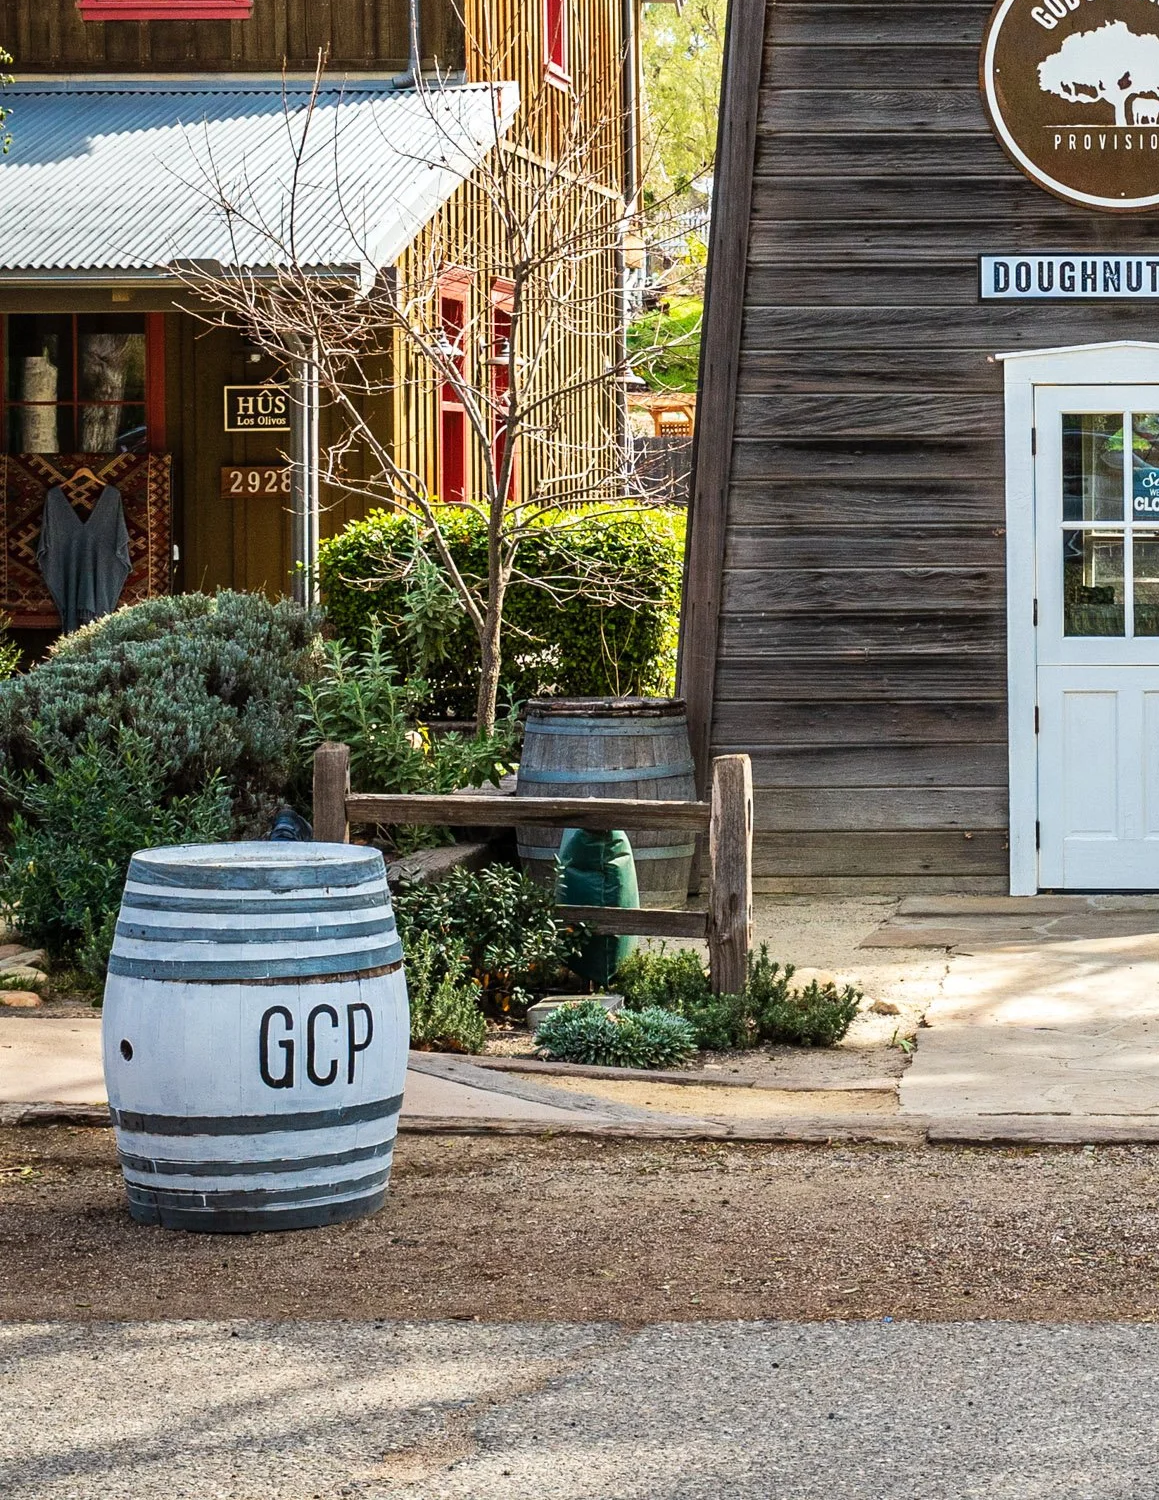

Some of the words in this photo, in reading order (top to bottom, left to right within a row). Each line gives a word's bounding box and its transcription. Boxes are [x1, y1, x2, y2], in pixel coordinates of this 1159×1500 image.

[237, 416, 255, 425] Los
[257, 416, 287, 425] Olivos
[259, 1003, 374, 1089] GCP
